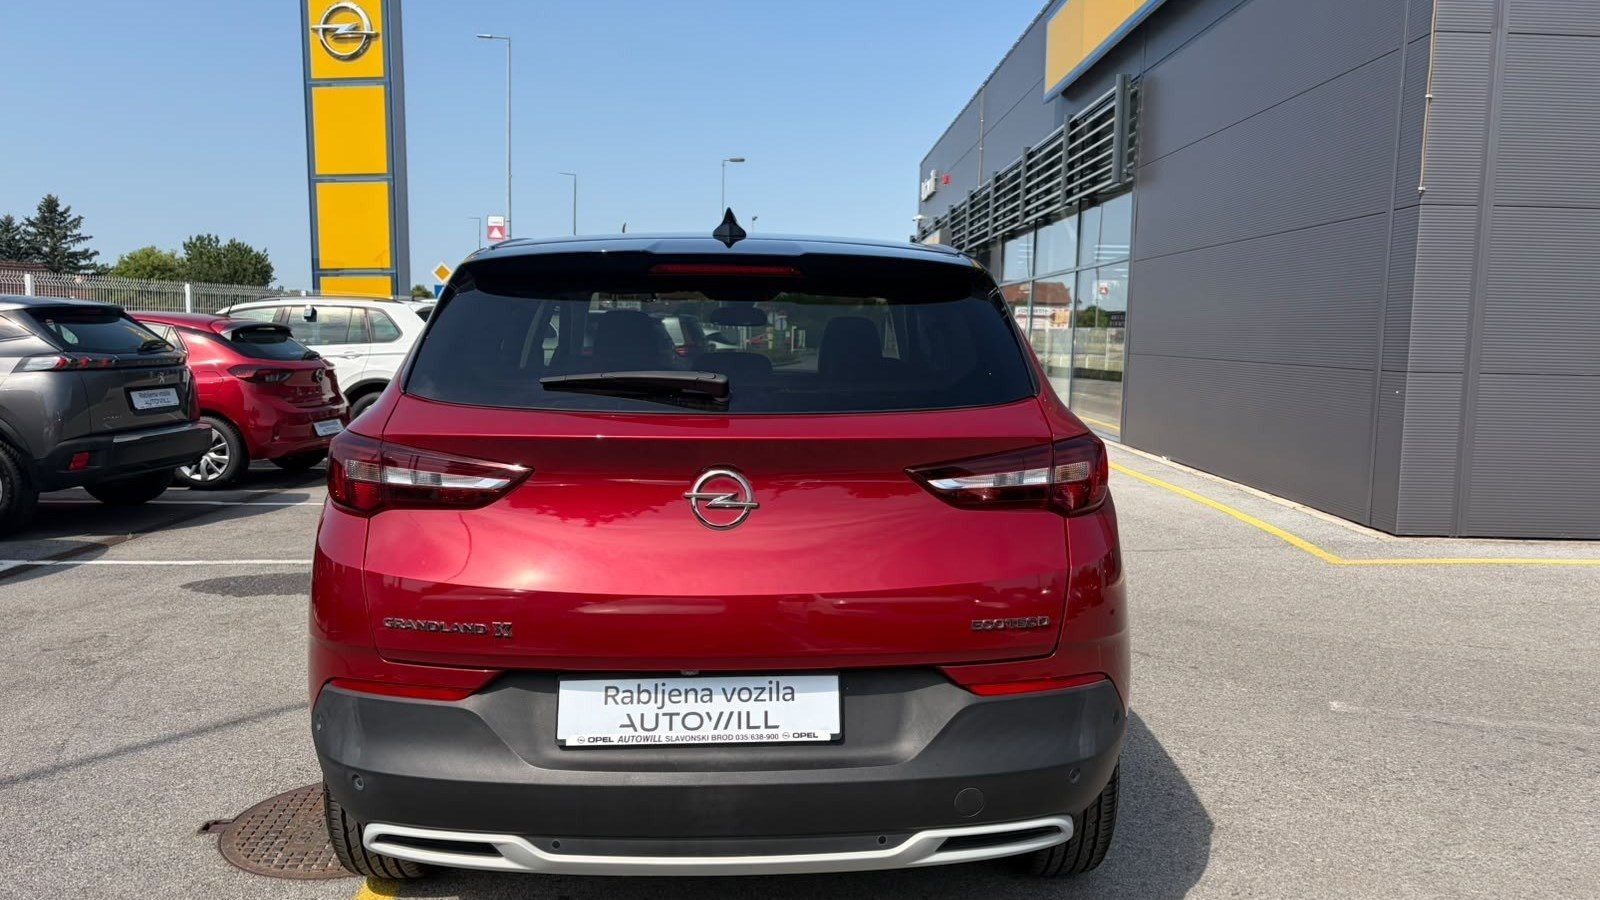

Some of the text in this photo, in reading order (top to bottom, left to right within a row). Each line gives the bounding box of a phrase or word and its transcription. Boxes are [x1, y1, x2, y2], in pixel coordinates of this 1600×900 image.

[383, 617, 513, 637] GRANDLAND X
[604, 680, 795, 709] Rabljena vozila
[619, 710, 780, 732] AUTOWILL
[617, 735, 663, 744] AUTOWILL
[665, 735, 710, 743] SLAVONSKI
[711, 734, 734, 742] BROD
